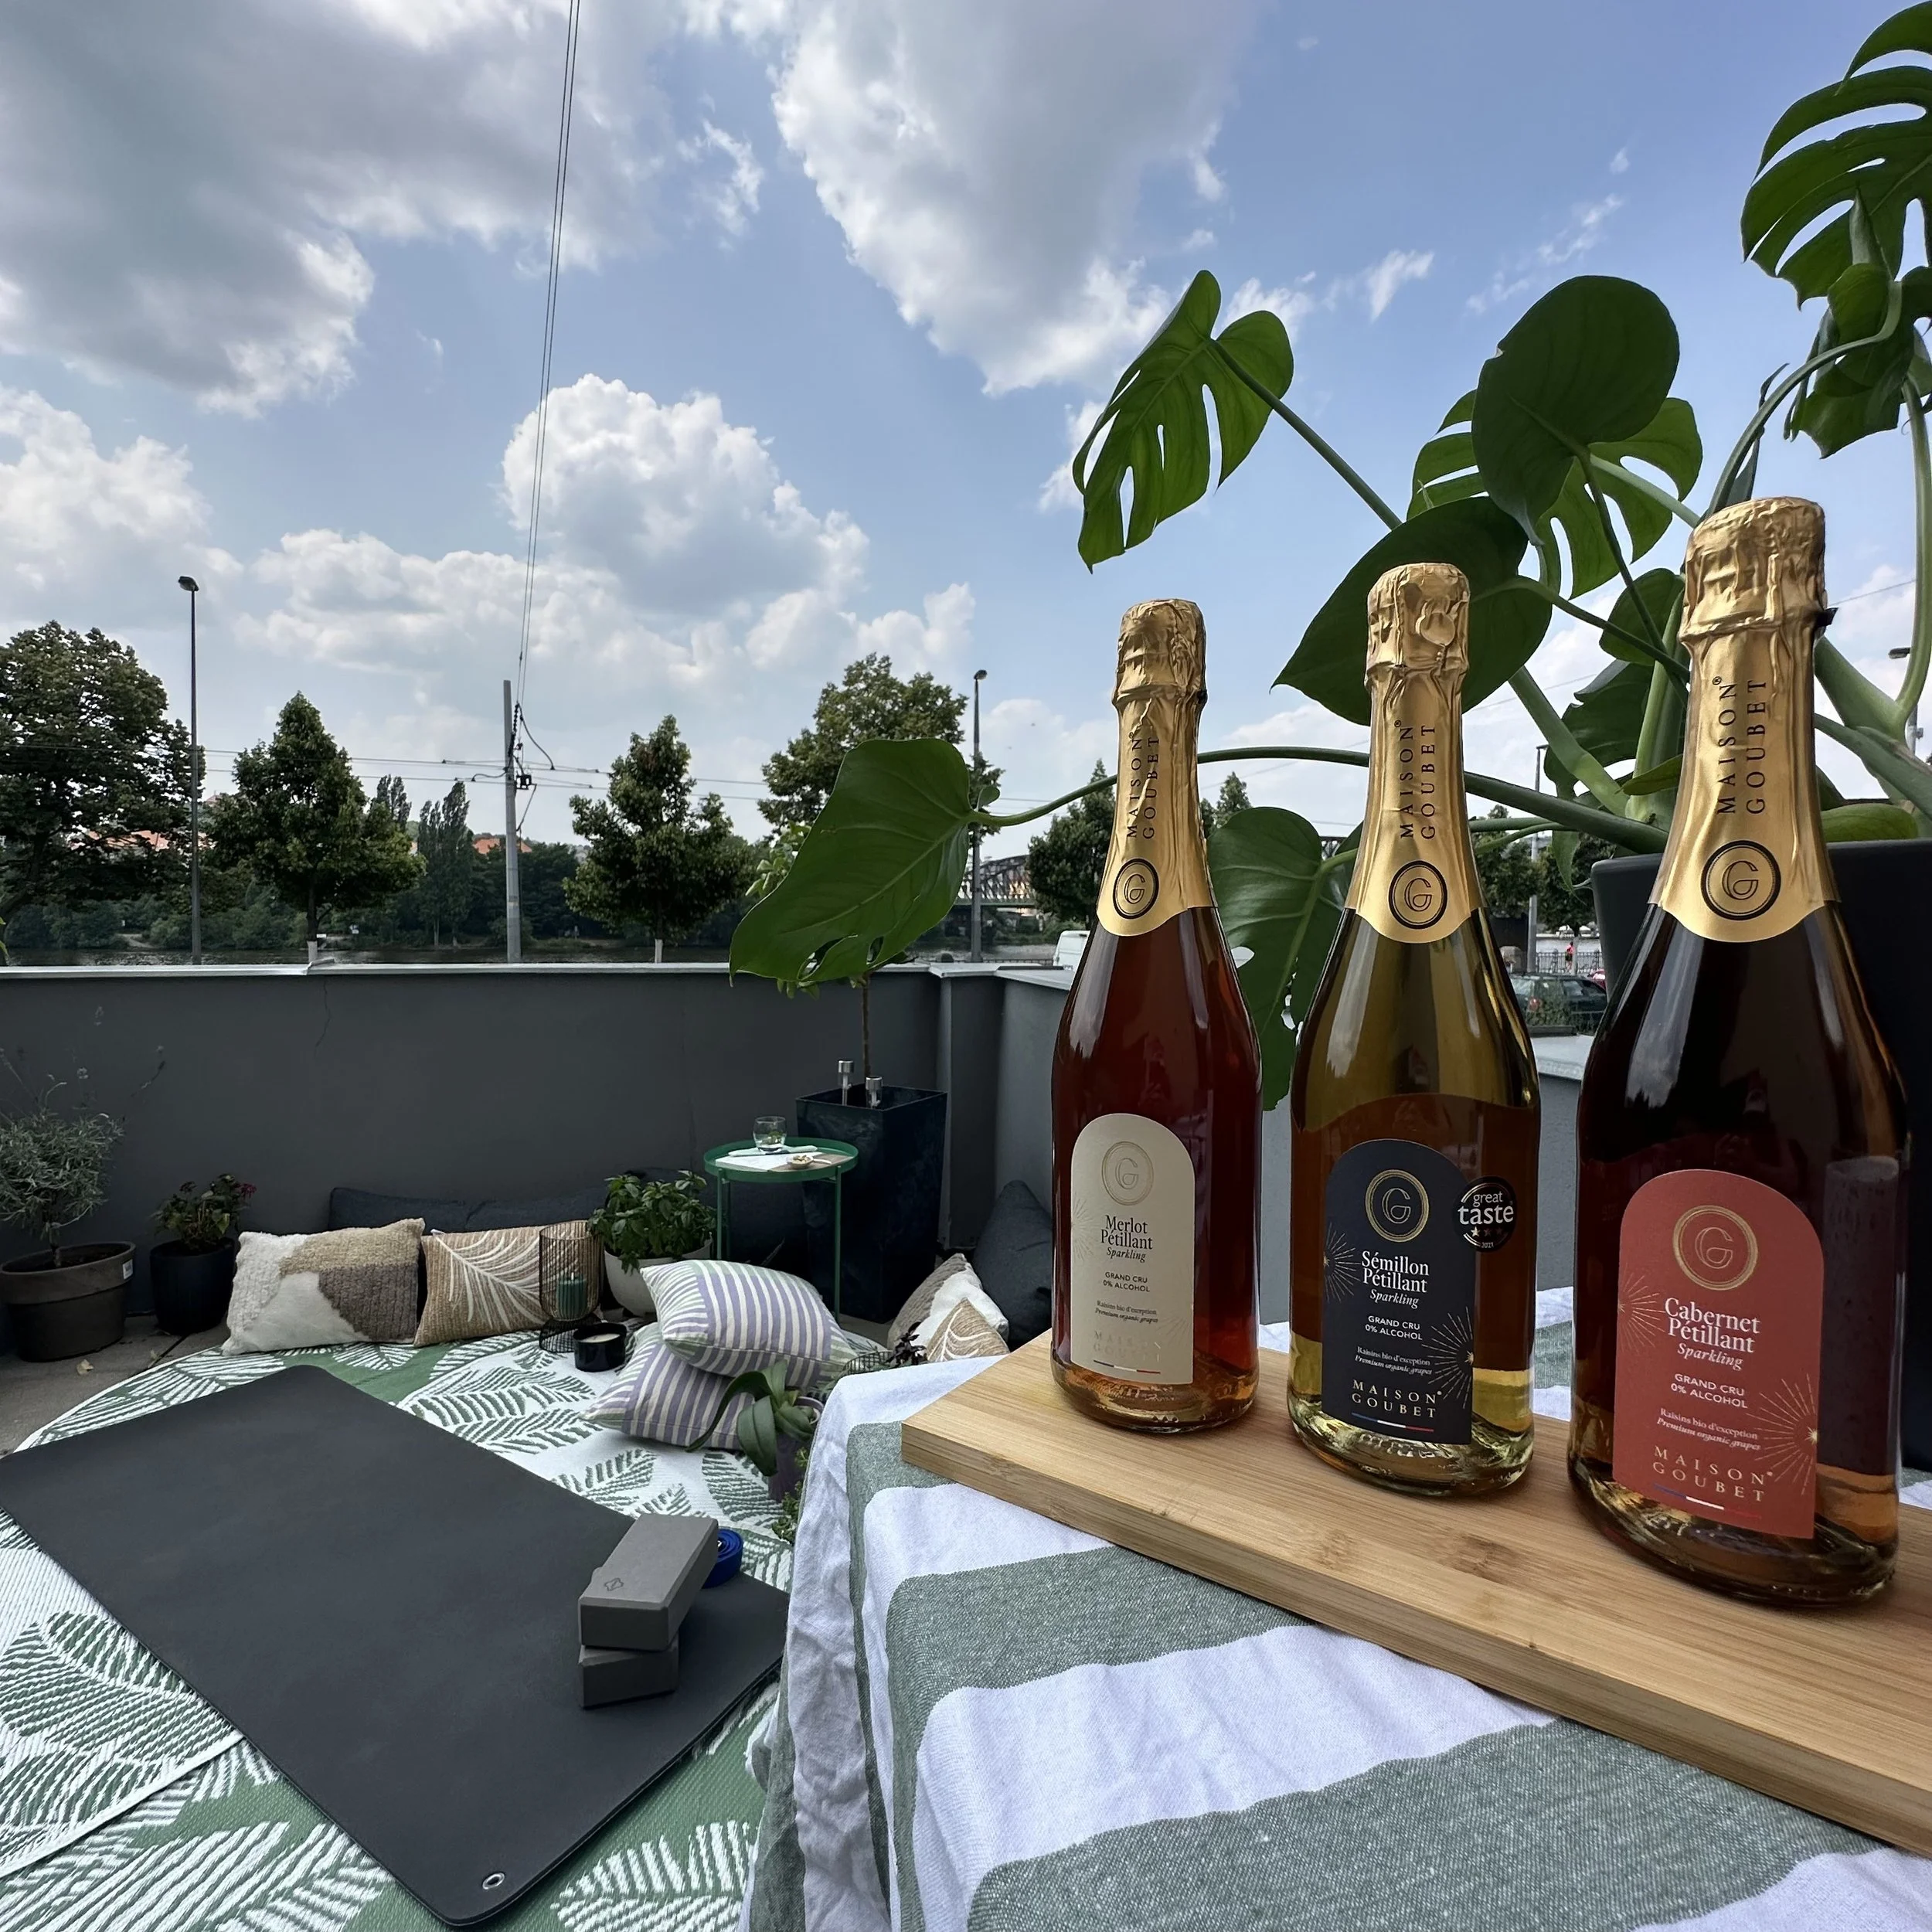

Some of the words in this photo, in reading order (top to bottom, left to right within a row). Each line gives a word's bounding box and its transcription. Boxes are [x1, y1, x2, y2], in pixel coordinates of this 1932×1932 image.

[1746, 679, 1767, 815] GOUBET
[1142, 736, 1159, 839] GOUBET
[1421, 725, 1435, 839] GOUBET
[1473, 1191, 1503, 1207] great
[1105, 1214, 1148, 1234] Merlot
[1458, 1205, 1514, 1225] taste
[1100, 1229, 1153, 1250] Pétillant
[1106, 1247, 1146, 1263] Sparkling
[1362, 1250, 1429, 1276] Sémillon
[1103, 1279, 1113, 1287] 0%
[1115, 1282, 1151, 1292] ALCOHOL
[1105, 1271, 1131, 1282] GRAND
[1362, 1267, 1428, 1293] Pétillant
[1116, 1304, 1125, 1312] bio
[1369, 1289, 1419, 1309] Sparkling
[1368, 1315, 1400, 1328] GRAND
[1402, 1321, 1420, 1331] CRU
[1665, 1297, 1761, 1334] Cabernet
[1365, 1324, 1378, 1333] 0%
[1379, 1326, 1423, 1341] ALCOHOL
[1668, 1317, 1755, 1353] Pétillant
[1355, 1355, 1385, 1368] Premium
[1385, 1362, 1410, 1372] organic
[1357, 1345, 1381, 1358] Raisins
[1382, 1352, 1393, 1360] bio
[1677, 1343, 1743, 1371] Sparkling
[1671, 1383, 1687, 1394] 0%
[1689, 1389, 1748, 1409] ALCOHOL
[1675, 1373, 1716, 1390] GRAND
[1719, 1384, 1745, 1396] CRU
[1352, 1393, 1436, 1418] GOUBET
[1657, 1417, 1696, 1436] Premium
[1696, 1430, 1730, 1445] organic
[1730, 1440, 1762, 1451] grapes
[1660, 1407, 1692, 1424] Raisins
[1692, 1417, 1707, 1429] bio
[1708, 1420, 1758, 1440] d'exception
[1652, 1461, 1765, 1502] GOUBET
